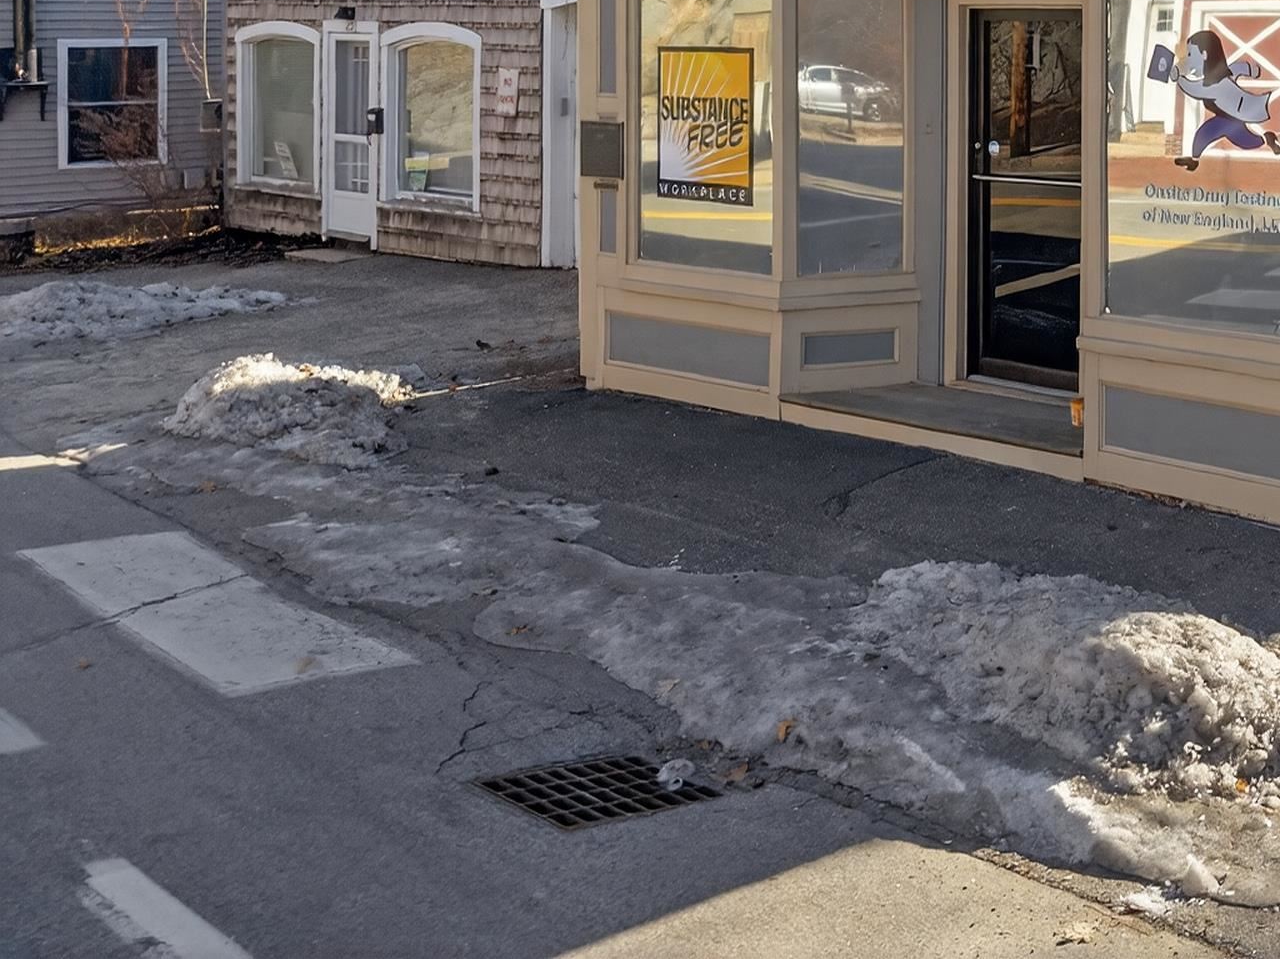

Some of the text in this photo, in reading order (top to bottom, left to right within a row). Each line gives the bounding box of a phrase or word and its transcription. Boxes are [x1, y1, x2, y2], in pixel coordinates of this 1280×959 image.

[661, 95, 749, 125] SUBSTANCE
[687, 119, 745, 154] FREE
[659, 182, 747, 202] WORKPLACE
[1145, 183, 1190, 202] Onsite
[1193, 186, 1230, 207] Drug
[1143, 206, 1157, 223] of
[1159, 208, 1191, 226] New
